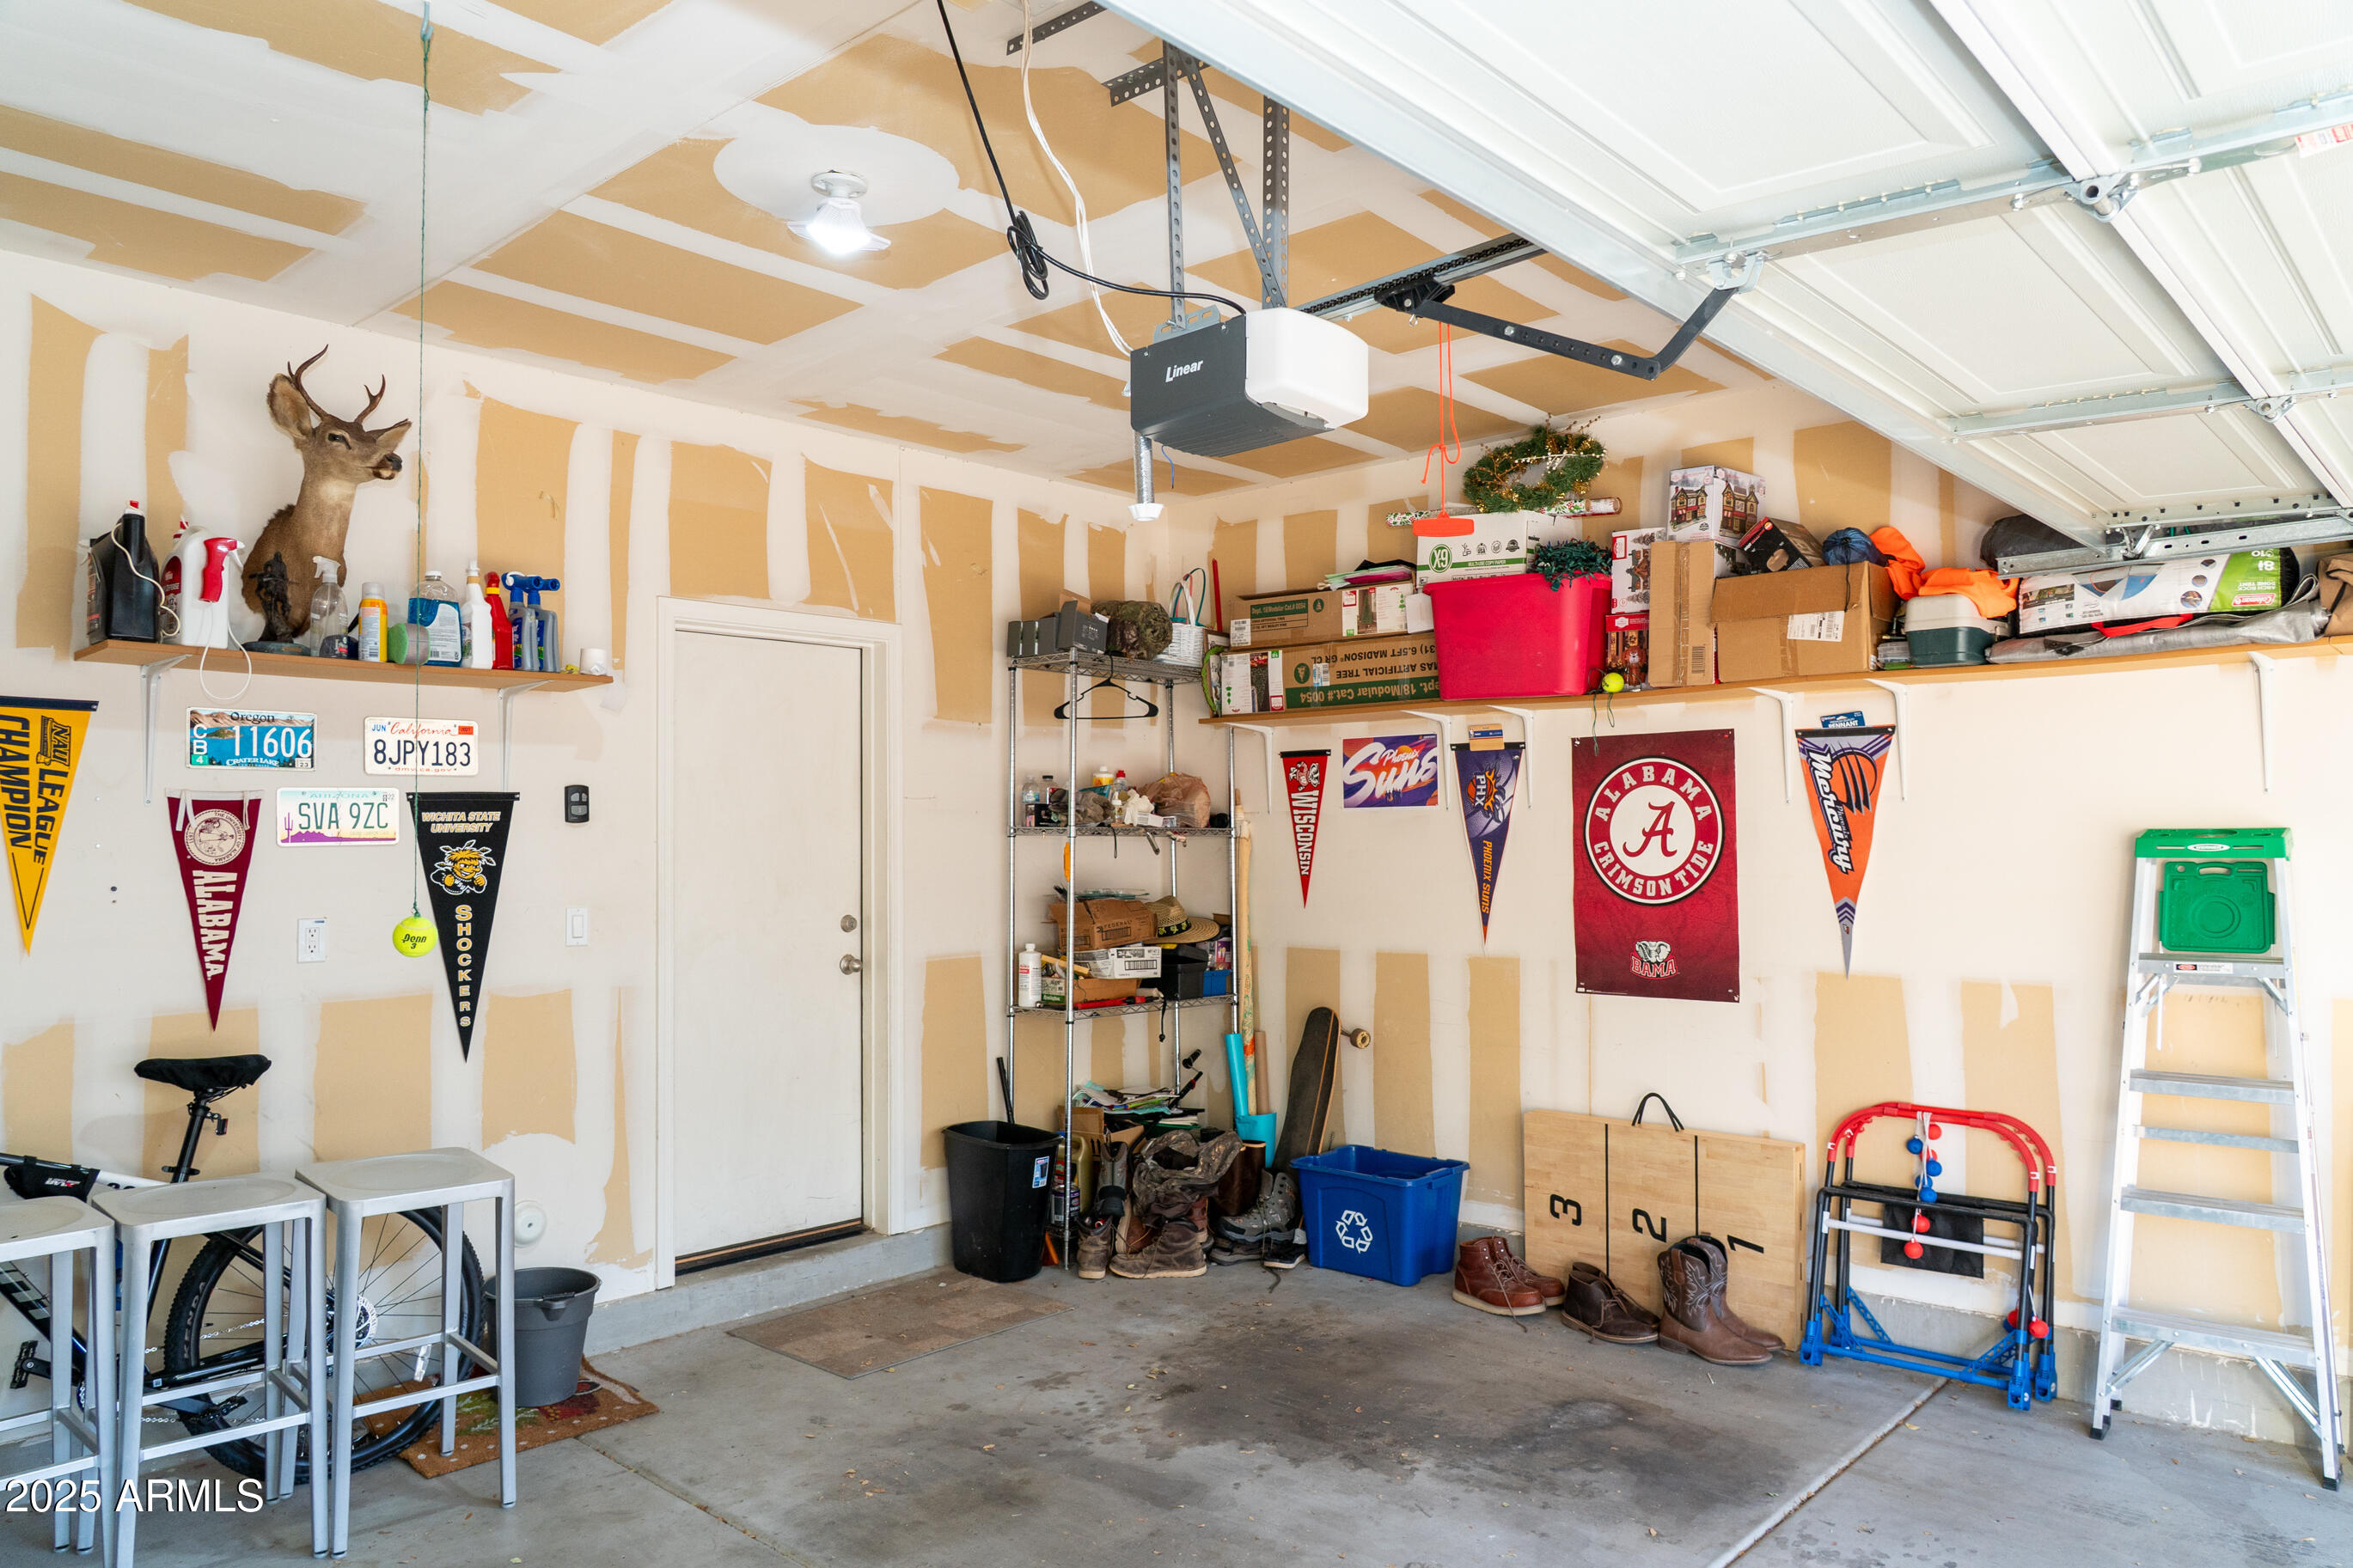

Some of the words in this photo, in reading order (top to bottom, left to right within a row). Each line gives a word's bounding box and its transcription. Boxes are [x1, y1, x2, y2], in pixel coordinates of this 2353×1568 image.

[1165, 360, 1203, 383] Linear
[2241, 595, 2272, 604] Coleman
[1325, 655, 1338, 663] GR
[1390, 646, 1417, 657] 6.5FT
[1335, 670, 1360, 679] TREE
[1362, 663, 1416, 676] ARTIFICIAL
[1299, 692, 1325, 704] 0054
[1327, 688, 1355, 700] Cat.#
[1357, 683, 1416, 697] 18/Modular
[1420, 679, 1439, 693] ept.
[230, 711, 275, 724] Oregon
[232, 725, 313, 758] 11606
[390, 722, 458, 739] California
[52, 723, 71, 768] NAU
[374, 739, 471, 766] 8JPY183
[1380, 748, 1420, 766] Phoenix
[226, 758, 260, 766] CRATER
[260, 758, 279, 767] LAKE
[0, 714, 32, 849] CHAMPION
[1474, 774, 1487, 806] PHX
[1595, 766, 1713, 822] ALABAMA
[34, 768, 69, 865] LEAGUE
[298, 802, 339, 830] SVA
[349, 802, 388, 829] 9ZC
[421, 812, 467, 822] WICHITA
[468, 811, 501, 821] STATE
[1807, 750, 1853, 874] Mercury
[1836, 803, 1849, 839] Phoenix
[431, 822, 493, 833] UNIVERSITY
[1291, 790, 1320, 876] WISCONSIN
[1623, 801, 1678, 857] A
[1482, 839, 1493, 882] PHOENIX
[1593, 841, 1672, 897] CRIMSON
[1675, 840, 1714, 888] TIDE
[1481, 882, 1491, 914] SUNS
[192, 869, 238, 979] ALABAMA
[401, 933, 427, 943] Penn
[455, 904, 473, 1027] SHOCKERS
[1631, 955, 1677, 978] BAMA
[1549, 1193, 1582, 1226] 3
[1632, 1208, 1667, 1243] 2
[1727, 1234, 1764, 1254] 1
